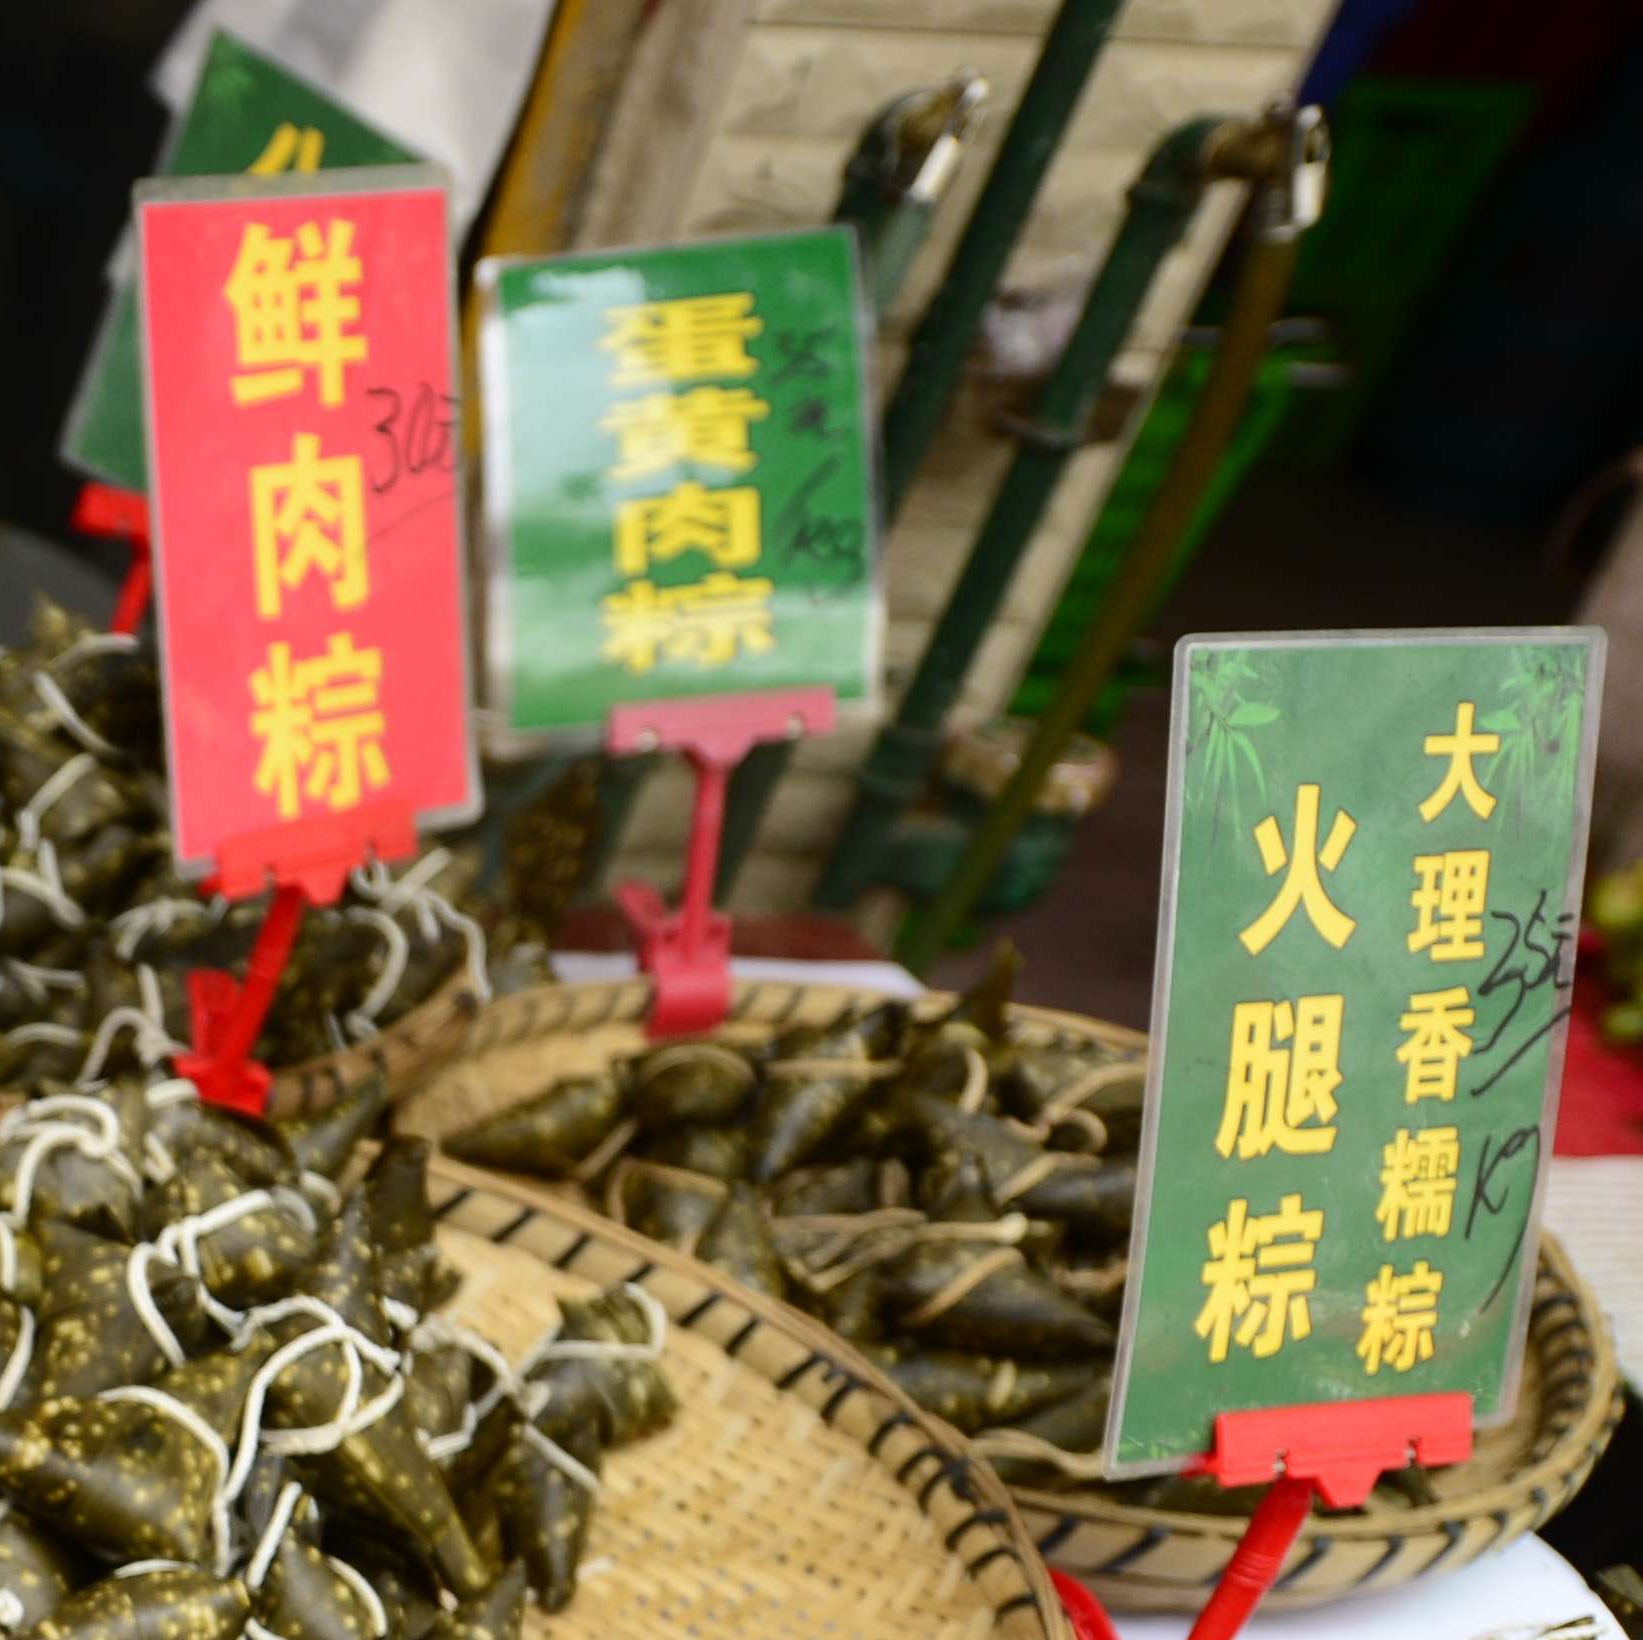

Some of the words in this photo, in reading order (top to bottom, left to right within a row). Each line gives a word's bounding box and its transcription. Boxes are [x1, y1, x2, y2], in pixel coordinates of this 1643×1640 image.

[223, 217, 391, 819] 鲜肉粽
[595, 290, 776, 678] 蛋黄肉粽
[1193, 782, 1359, 1364] 火腿粽
[1357, 702, 1501, 1375] 大理香糯粽
